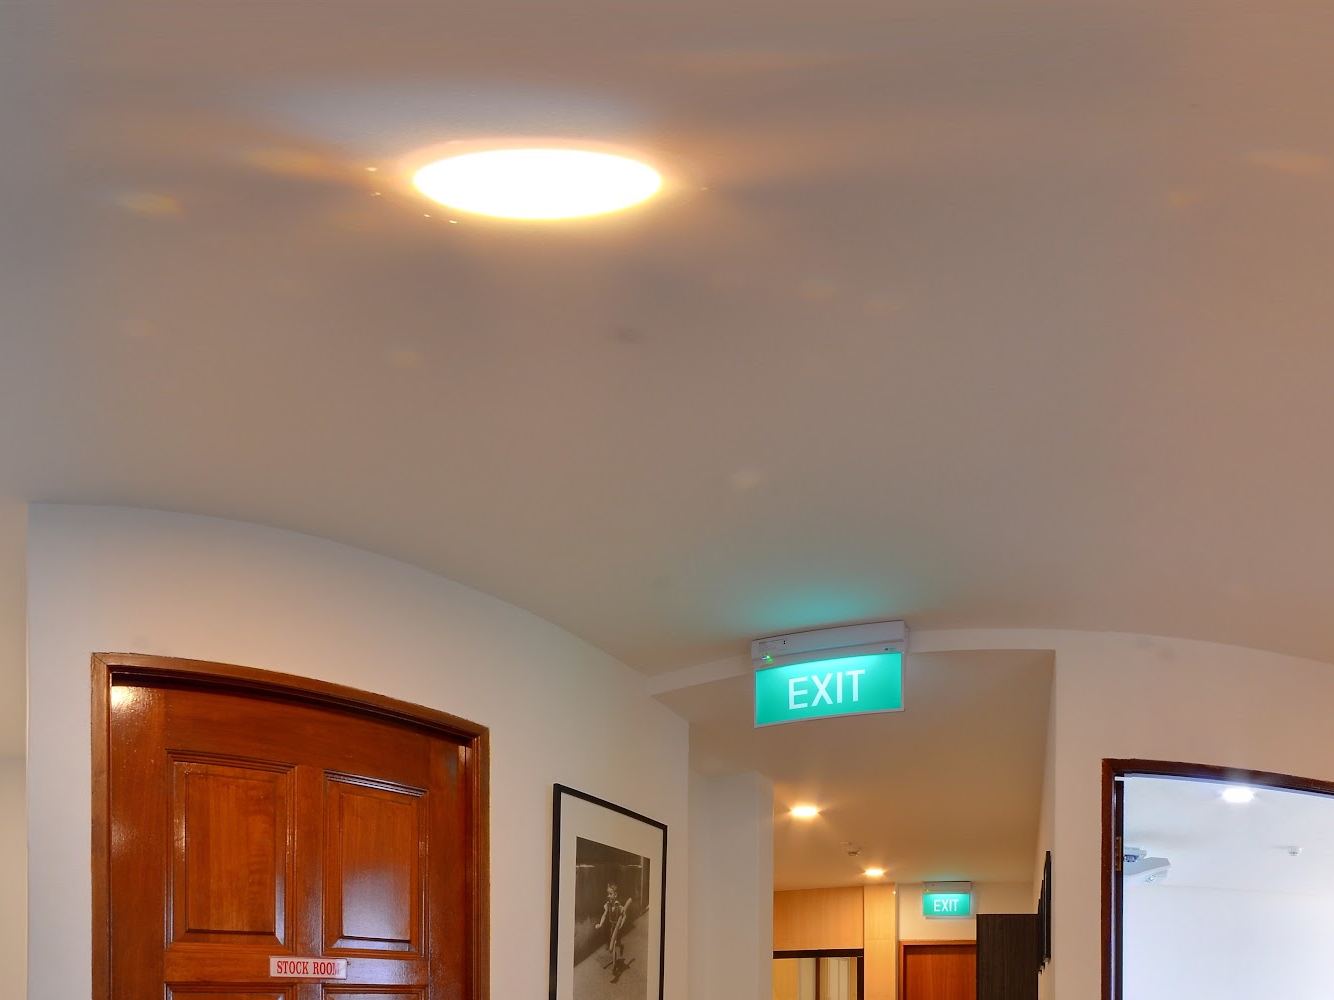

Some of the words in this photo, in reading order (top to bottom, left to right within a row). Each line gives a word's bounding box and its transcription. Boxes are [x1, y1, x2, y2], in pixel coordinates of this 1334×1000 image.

[788, 669, 866, 711] EXIT
[933, 899, 959, 912] EXIT
[276, 960, 309, 975] STOCK
